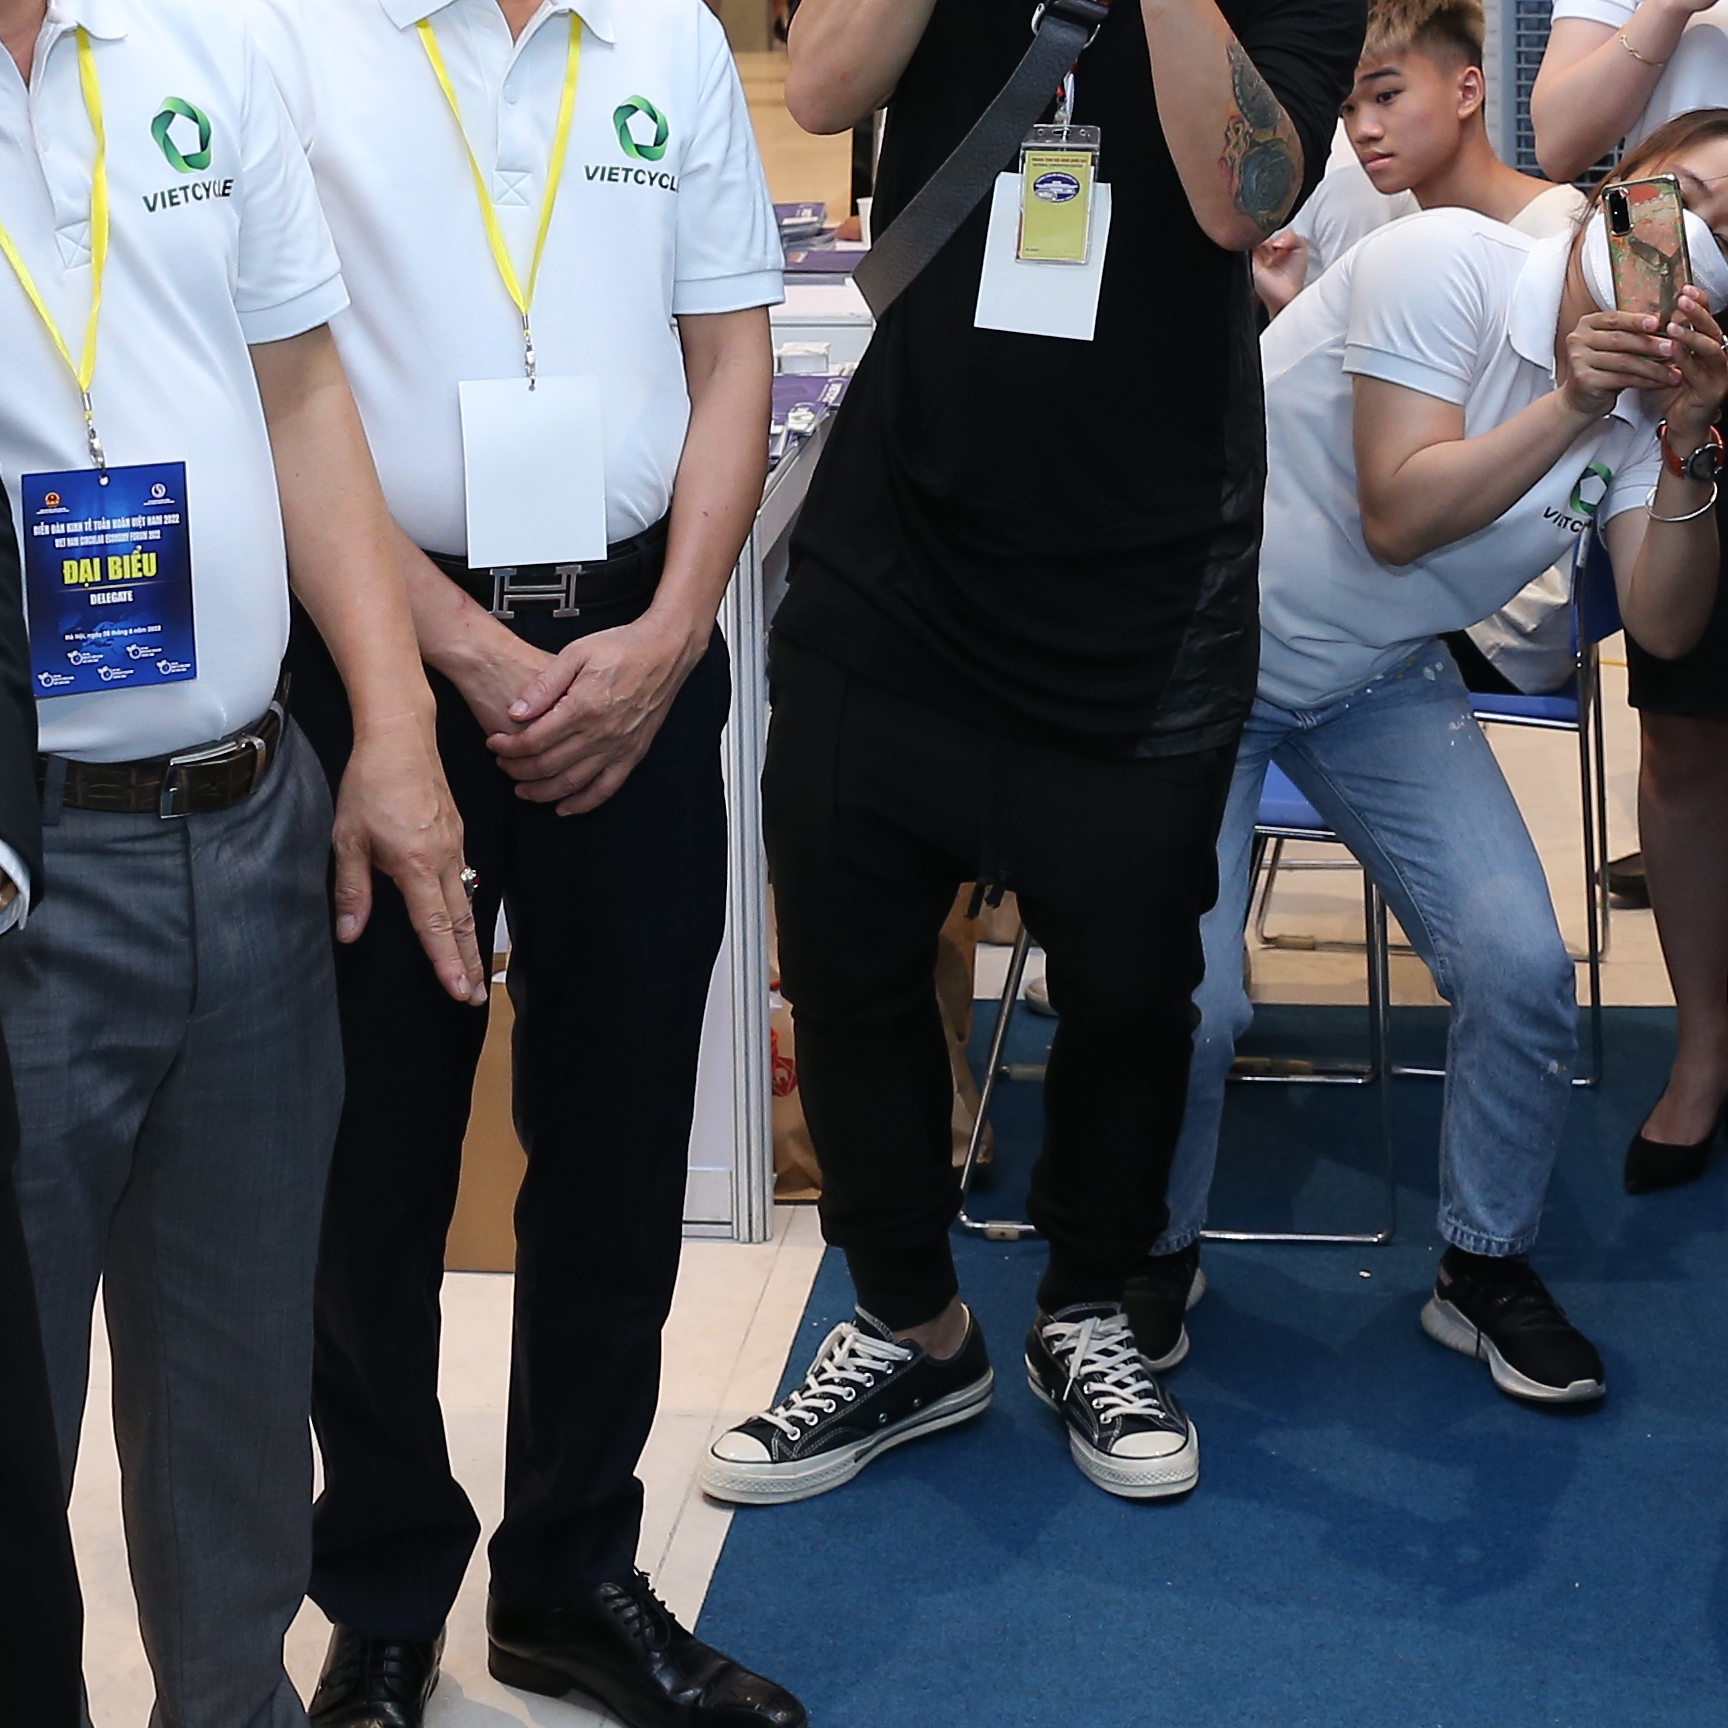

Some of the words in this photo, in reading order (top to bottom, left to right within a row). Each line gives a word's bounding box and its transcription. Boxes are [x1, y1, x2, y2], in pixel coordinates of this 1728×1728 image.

[584, 165, 679, 193] VIETCYCL
[63, 557, 101, 588] ĐẠI
[107, 545, 157, 581] BIỂU
[90, 590, 134, 606] DELEGATE
